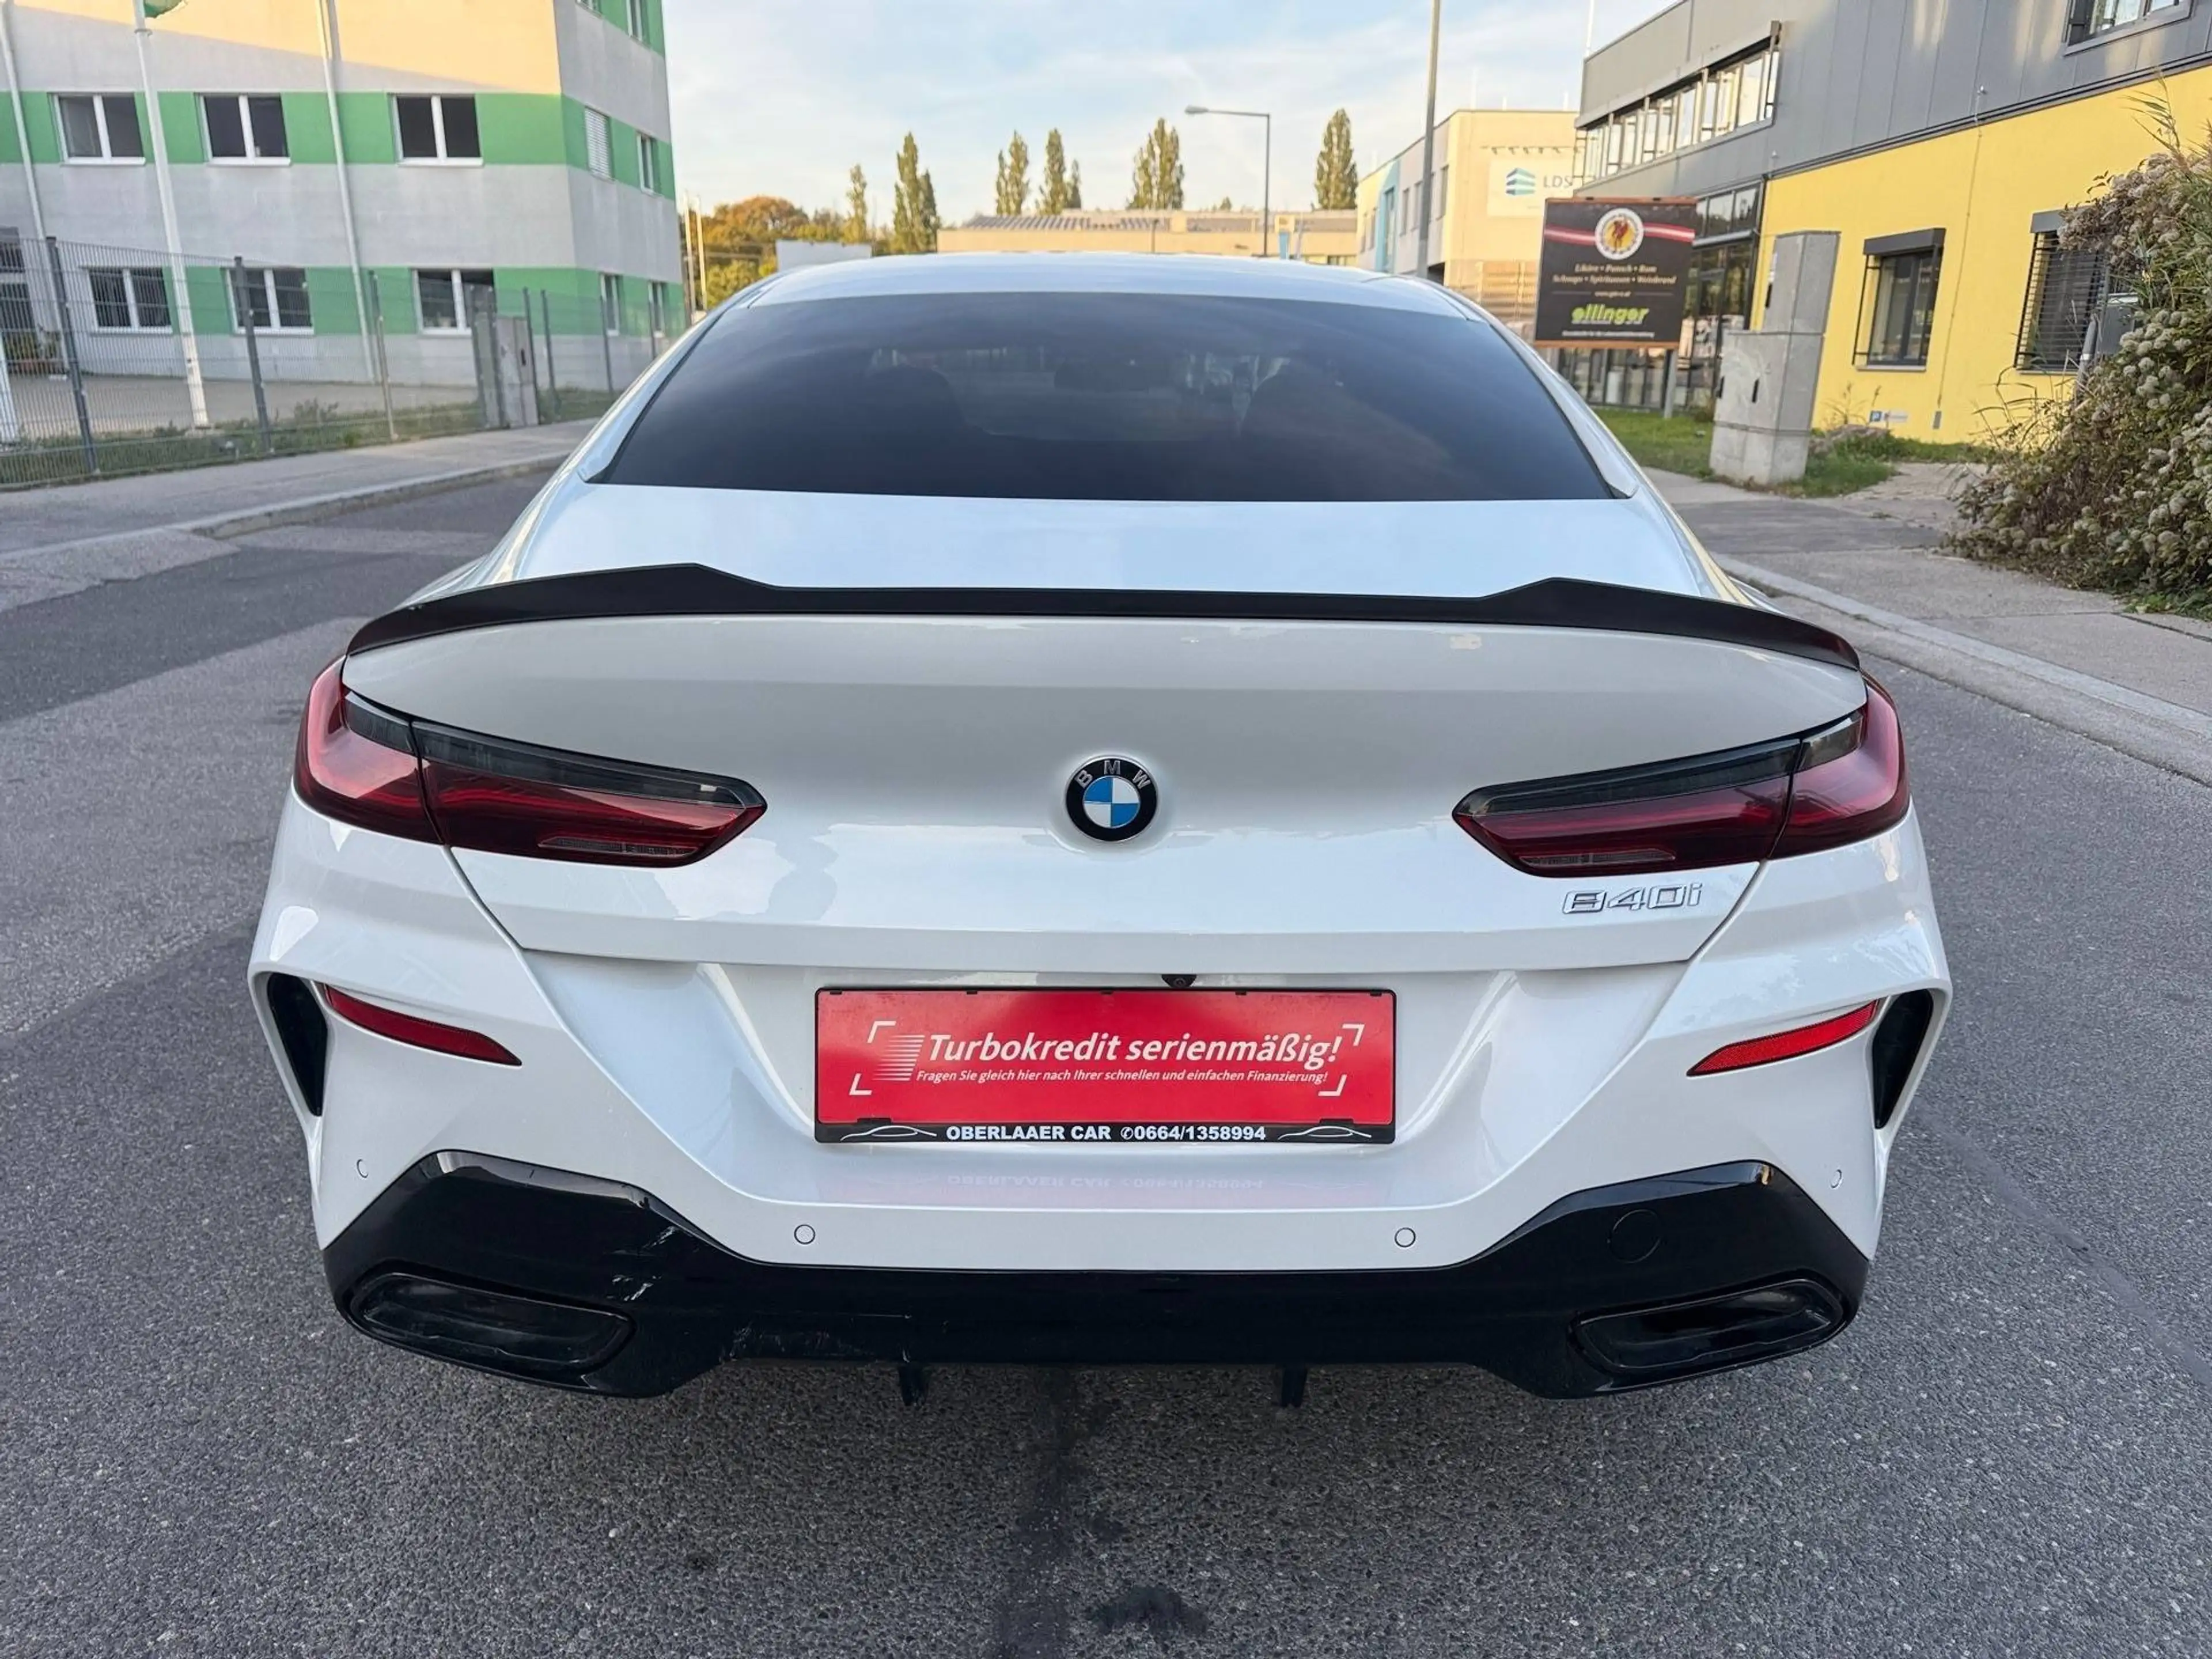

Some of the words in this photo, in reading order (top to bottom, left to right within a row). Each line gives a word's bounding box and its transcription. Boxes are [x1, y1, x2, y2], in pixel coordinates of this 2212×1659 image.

[1571, 304, 1650, 325] ellinger
[1075, 759, 1152, 789] BMW
[1562, 882, 1703, 915] 840i
[930, 1032, 1122, 1061] Turbokredit
[1124, 1033, 1343, 1070] serienmäßig!
[916, 1070, 957, 1084] Fragen
[958, 1070, 978, 1081] Sie
[978, 1069, 1015, 1084] gleich
[1017, 1069, 1040, 1081] hier
[1043, 1069, 1071, 1081] nach
[1073, 1069, 1103, 1081] Ihrer
[1104, 1069, 1160, 1081] schnellen
[1162, 1069, 1188, 1081] und
[1187, 1069, 1245, 1081] einfachen
[1246, 1069, 1328, 1085] Finanzierung!
[946, 1126, 1066, 1141] OBERLAAER
[1070, 1126, 1112, 1141] CAR
[1135, 1126, 1266, 1141] 0664/1358994
